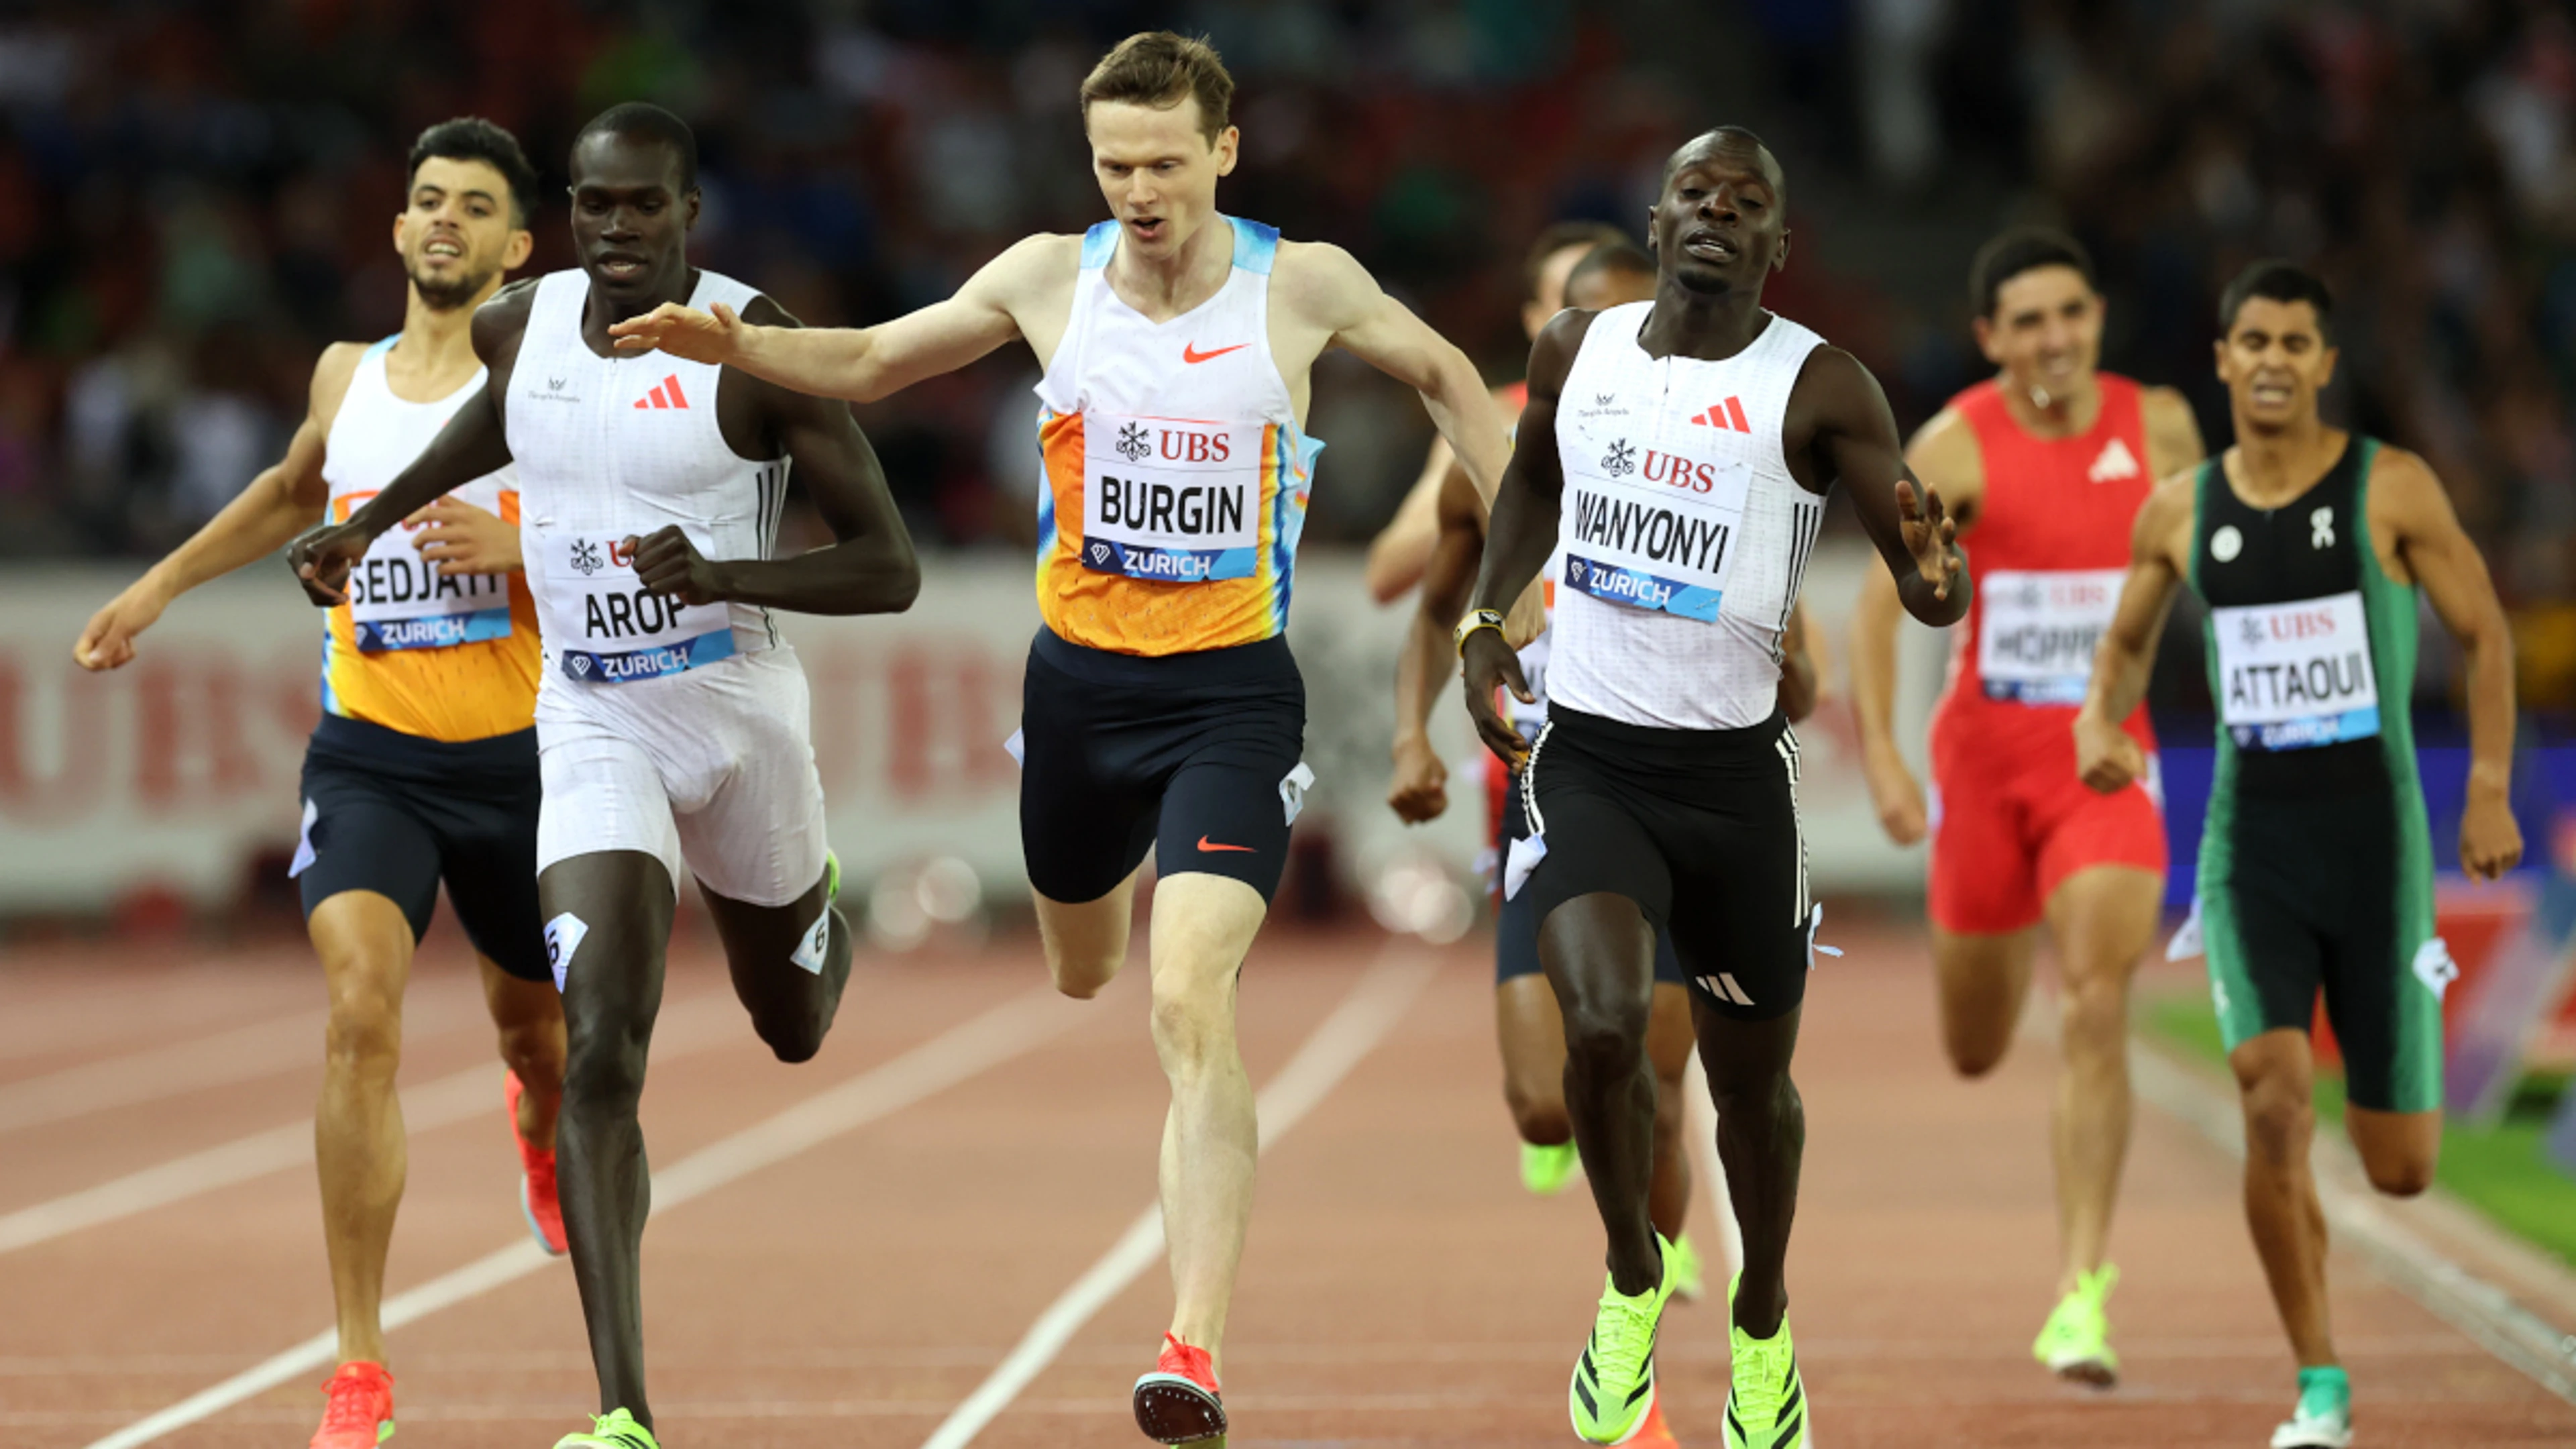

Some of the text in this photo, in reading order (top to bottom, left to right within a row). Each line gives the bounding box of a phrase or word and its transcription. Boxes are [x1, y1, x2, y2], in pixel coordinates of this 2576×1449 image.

[1160, 429, 1230, 462] UBS
[1642, 449, 1716, 494] UBS
[1101, 475, 1244, 535] BURGIN
[1575, 489, 1729, 574] WANYONYI
[1122, 550, 1212, 576] ZURICH
[1589, 568, 1672, 605] ZURICH
[380, 618, 465, 645] ZURICH
[586, 588, 686, 638] AROP
[2269, 608, 2337, 643] UBS
[602, 647, 690, 678] ZURICH
[2231, 652, 2367, 709] ATTAOUI
[546, 928, 560, 965] 6
[815, 921, 825, 955] 6
